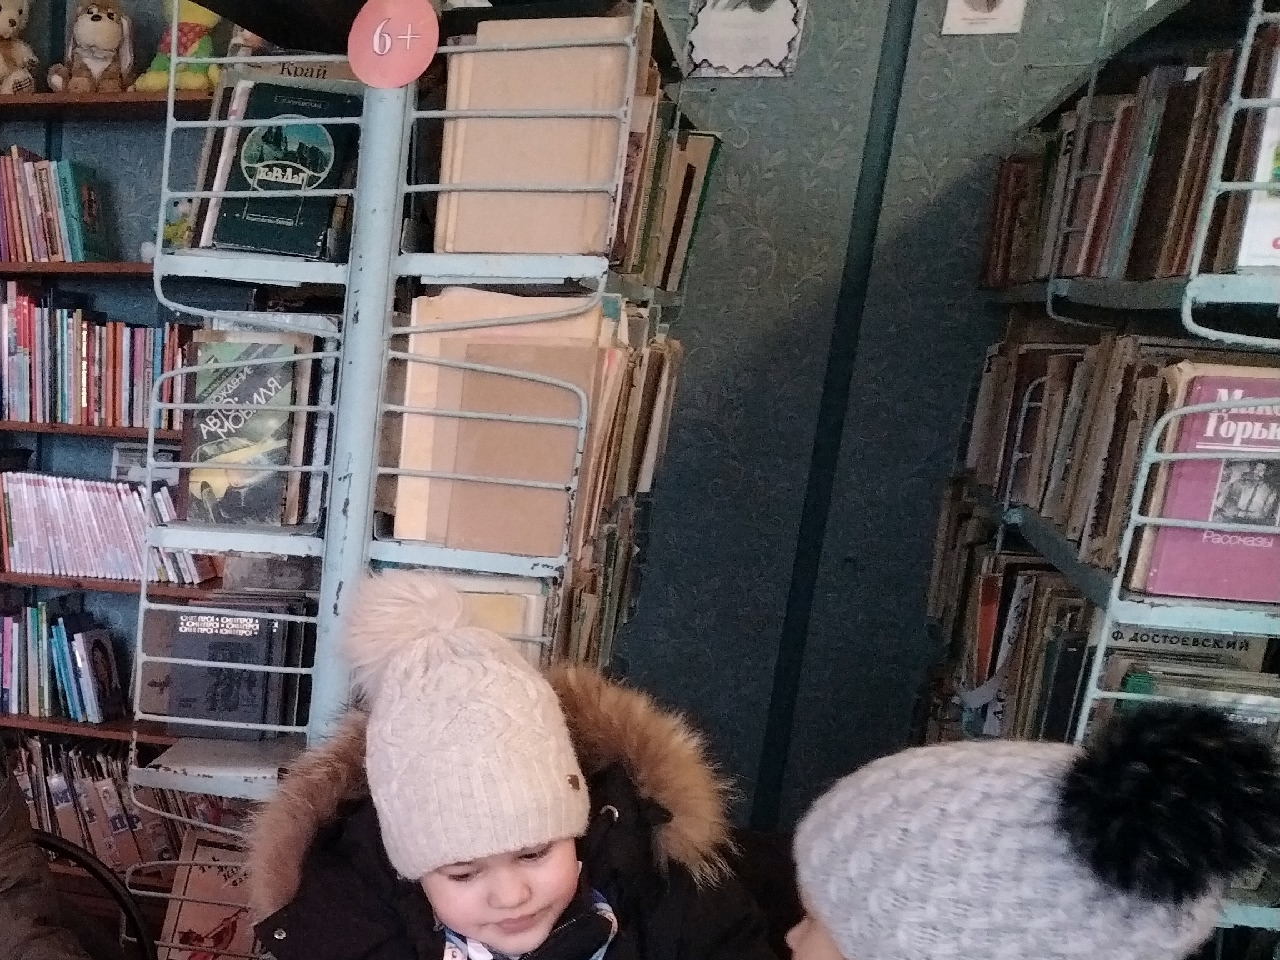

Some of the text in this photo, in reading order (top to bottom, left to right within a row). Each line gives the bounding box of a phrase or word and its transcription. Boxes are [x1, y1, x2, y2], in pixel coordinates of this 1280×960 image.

[372, 17, 421, 56] 6+
[279, 61, 329, 80] Край
[1202, 530, 1274, 548] Рассказы
[1128, 632, 1250, 651] ДОСТОЕВСКИЙ
